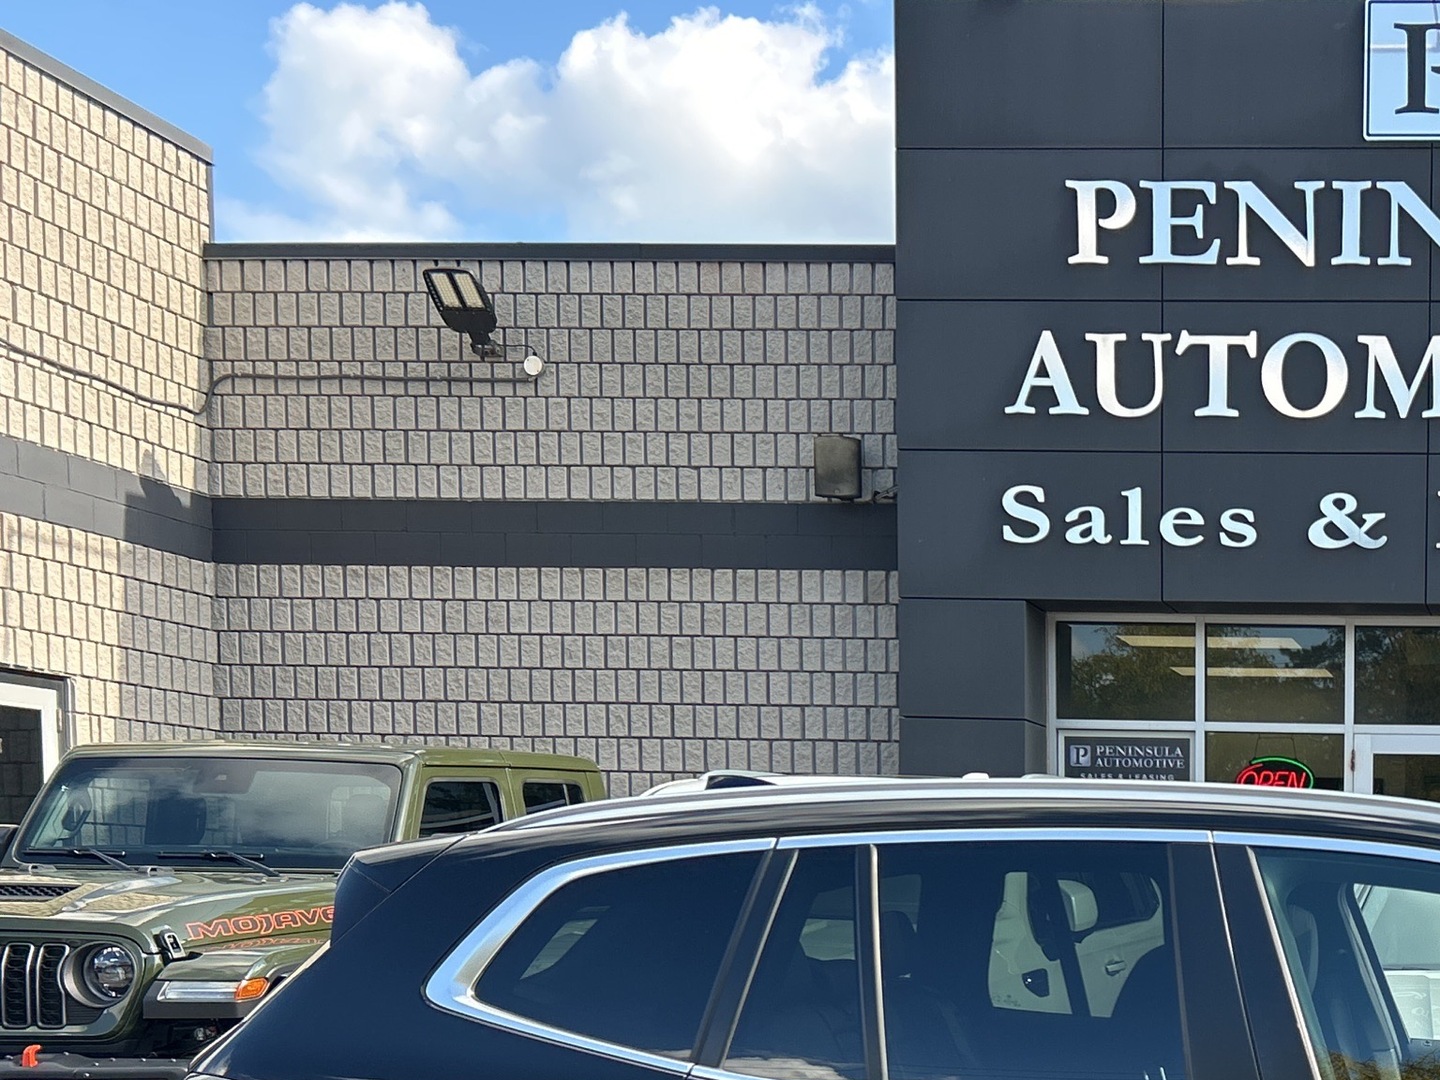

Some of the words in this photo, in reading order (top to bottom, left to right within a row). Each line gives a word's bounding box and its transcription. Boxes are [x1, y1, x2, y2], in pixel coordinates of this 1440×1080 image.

[1000, 484, 1260, 548] Sales
[1307, 491, 1388, 549] &
[1073, 746, 1088, 765] P
[1095, 745, 1184, 758] PENINSULA
[1094, 757, 1186, 769] AUTOMOTIVE
[1240, 770, 1306, 788] OPEN
[186, 905, 335, 940] MOJAVE
